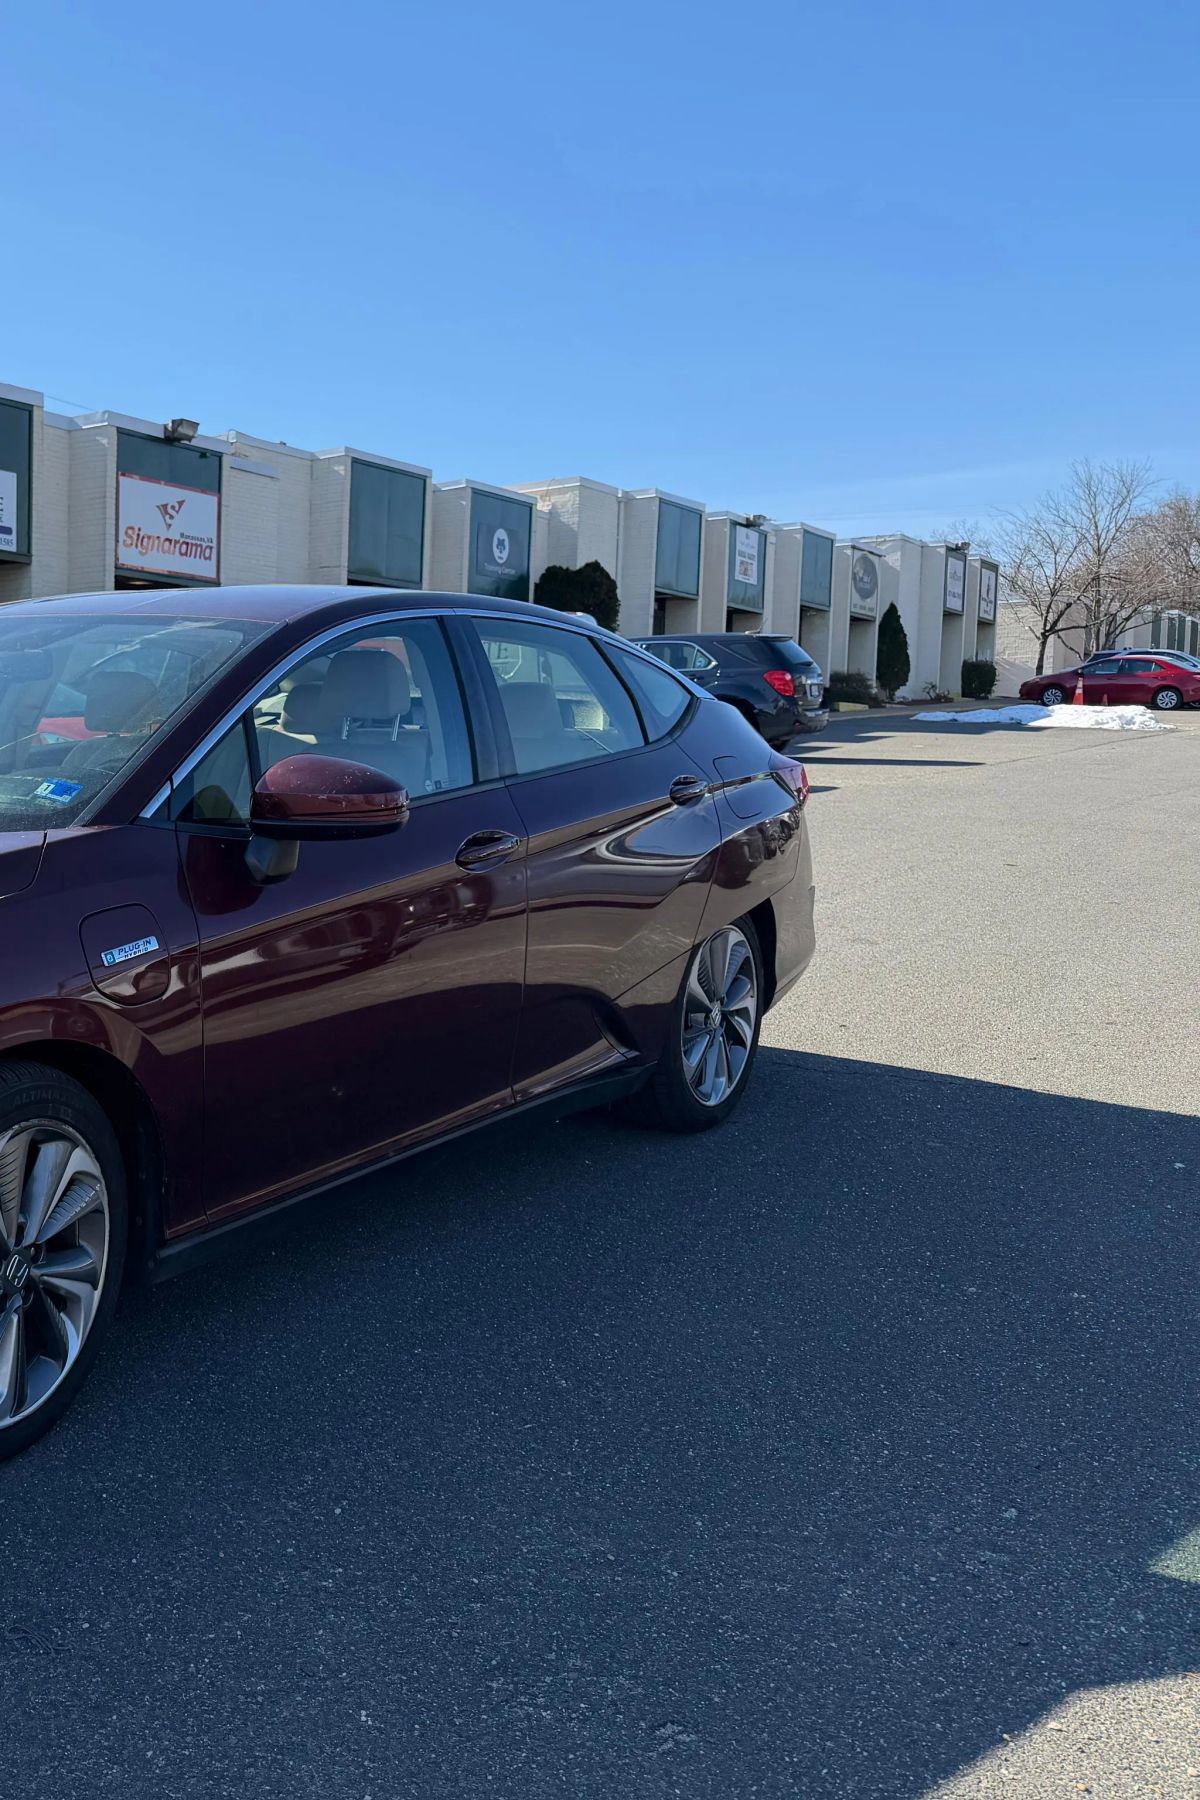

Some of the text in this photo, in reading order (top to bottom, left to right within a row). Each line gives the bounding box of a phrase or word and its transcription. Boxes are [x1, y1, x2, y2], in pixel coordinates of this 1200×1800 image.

[123, 526, 214, 561] Signarama
[118, 938, 152, 956] PLUG-IN
[124, 947, 149, 959] HYBRID
